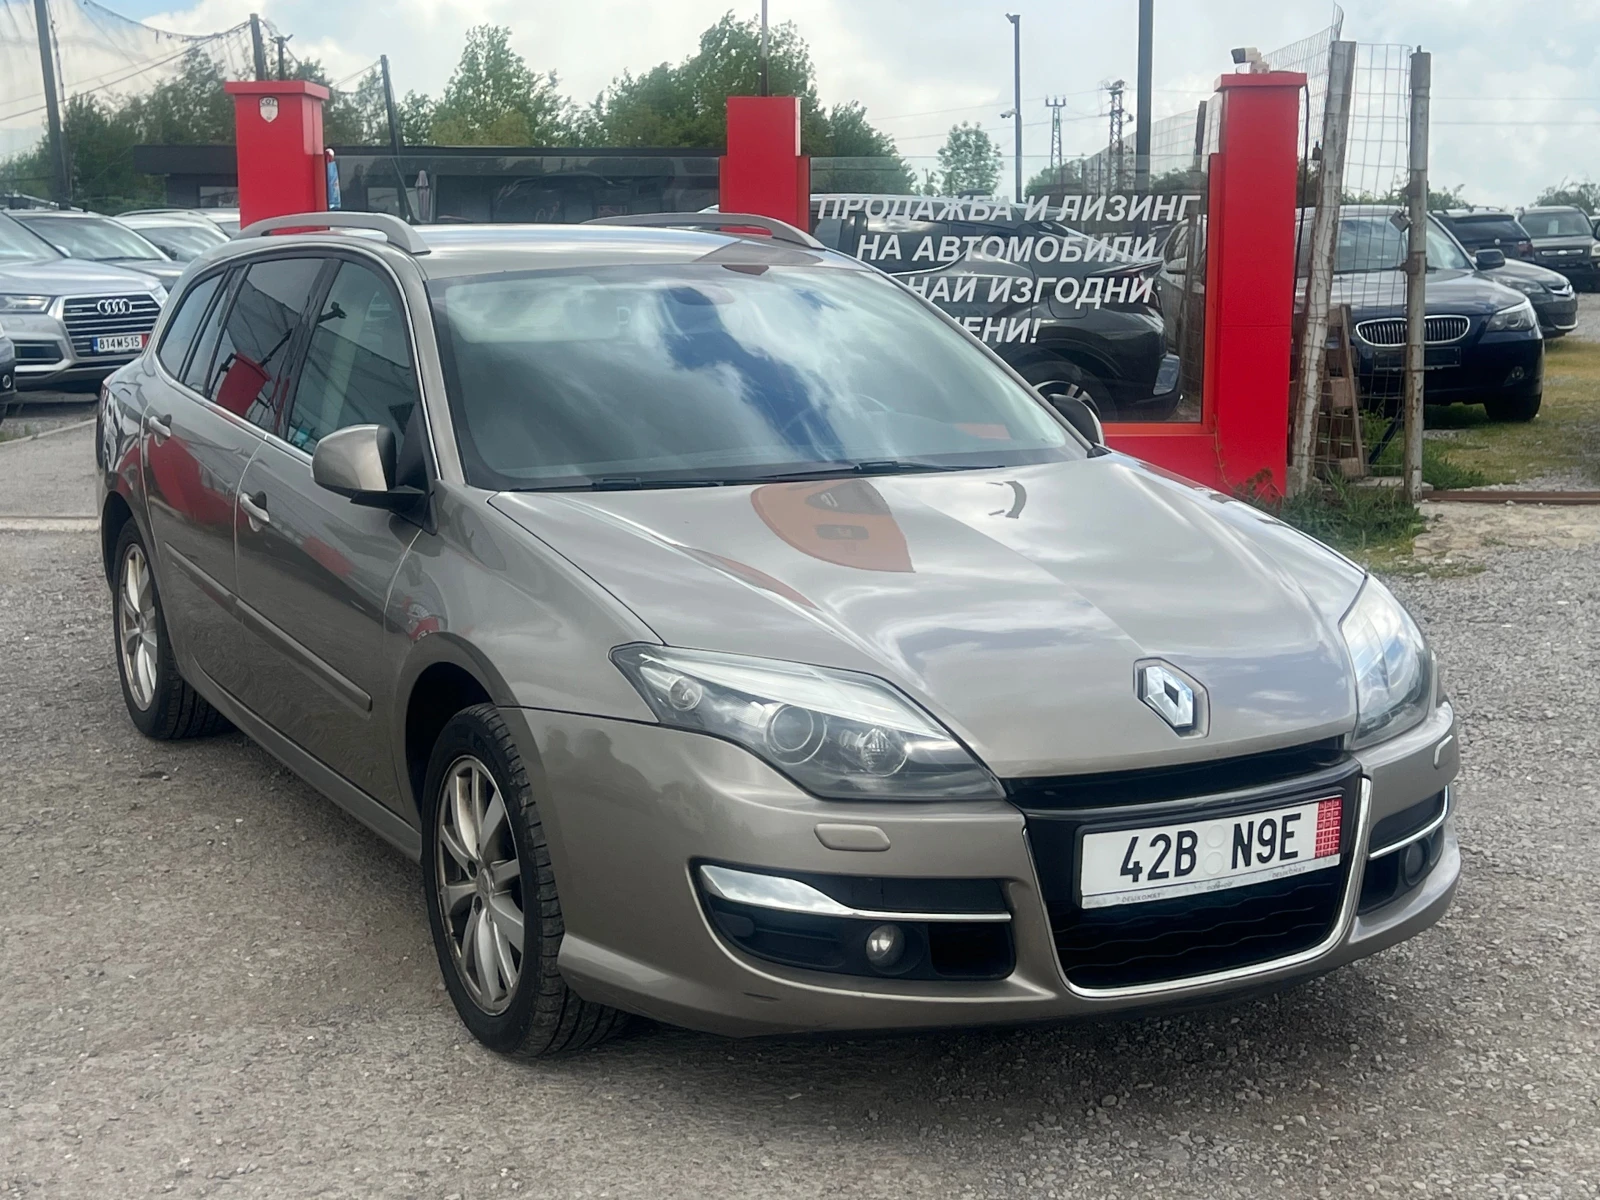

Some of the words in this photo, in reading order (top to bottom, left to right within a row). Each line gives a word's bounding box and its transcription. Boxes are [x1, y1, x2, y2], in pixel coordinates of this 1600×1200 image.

[817, 194, 1012, 223] ПРОДАЖБА
[1023, 195, 1049, 221] И
[1056, 195, 1201, 221] ЛИЗИНГ
[856, 235, 902, 260] НА
[911, 235, 1157, 263] АВТОМОБИЛИ
[987, 276, 1151, 310] ИЗГОДНИ
[99, 336, 140, 349] 814M515
[954, 316, 1042, 343] ЕНИ!
[1120, 829, 1198, 883] 42B
[1231, 813, 1301, 870] N9E
